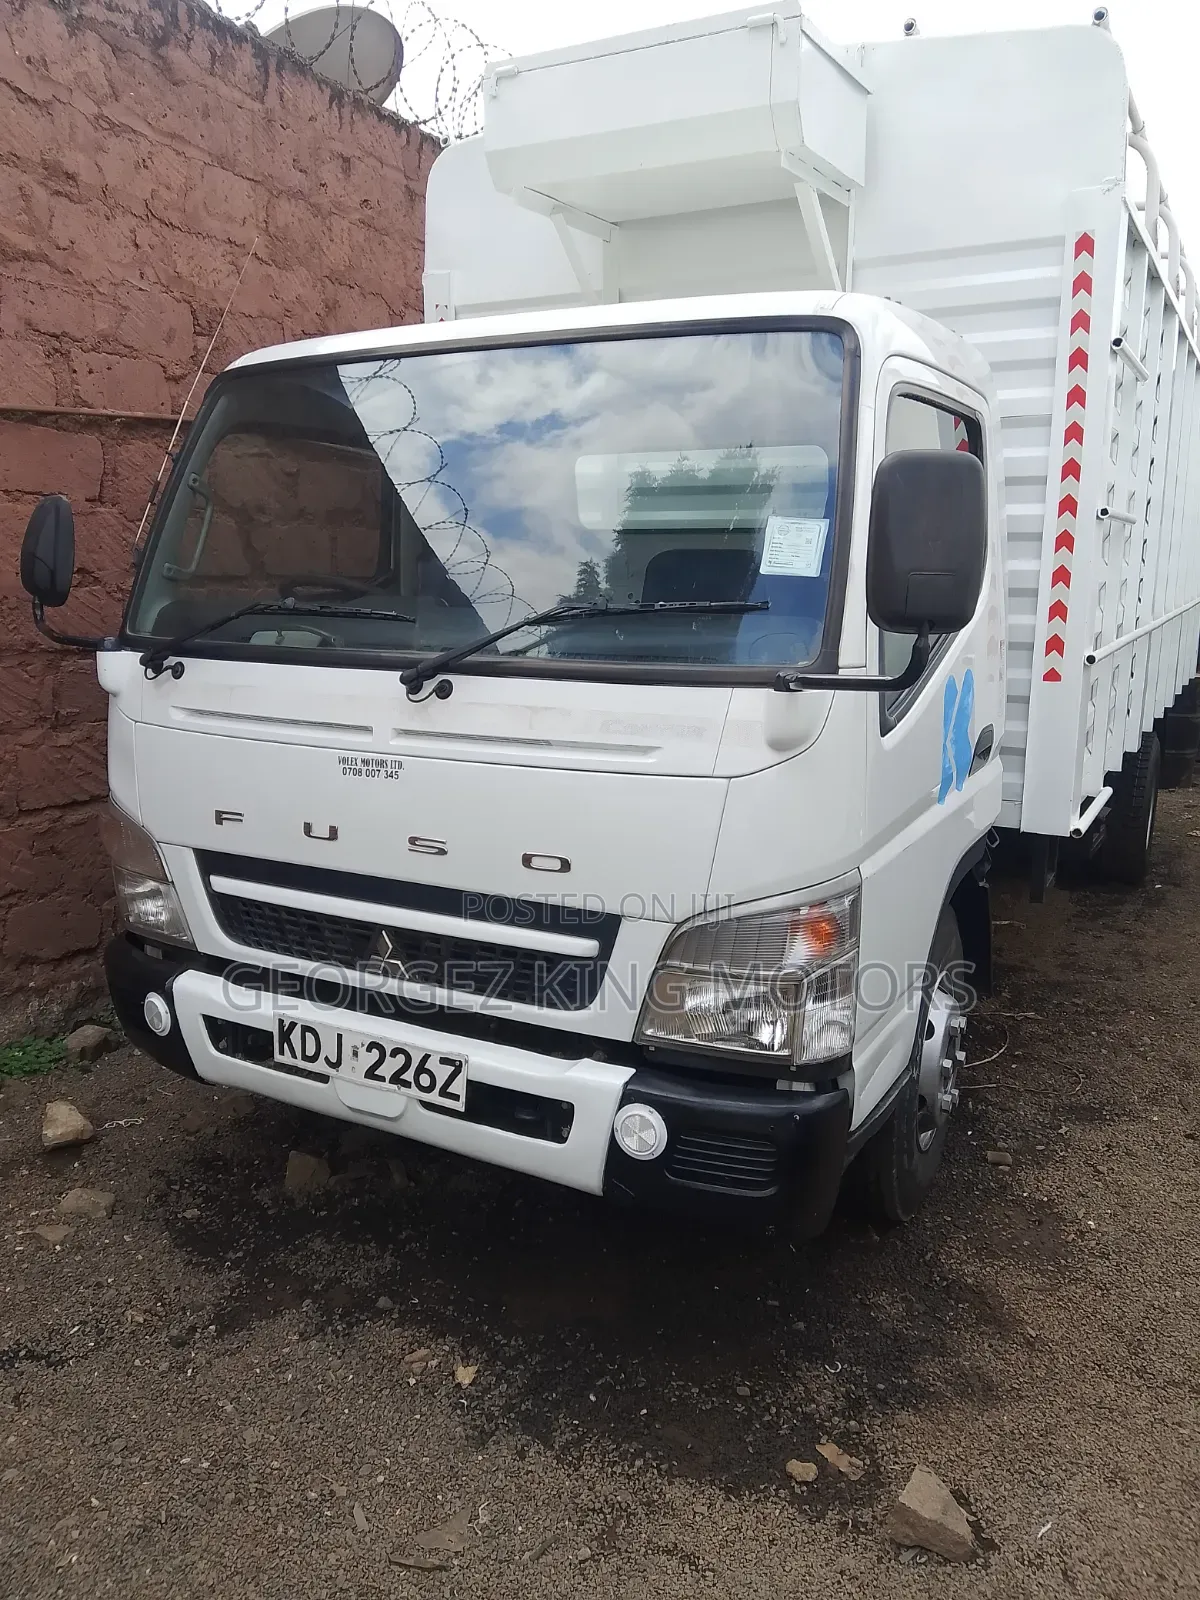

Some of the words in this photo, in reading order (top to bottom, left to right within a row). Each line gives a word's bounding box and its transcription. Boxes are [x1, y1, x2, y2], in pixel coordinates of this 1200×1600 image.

[337, 755, 359, 767] VOLEX
[360, 757, 389, 769] MOTORS
[390, 759, 405, 771] LTD.
[342, 766, 363, 777] 0708
[365, 768, 381, 779] 007
[383, 769, 400, 780] 345
[214, 808, 572, 874] FUSO
[277, 1017, 344, 1070] KDJ
[363, 1040, 463, 1103] 226Z
